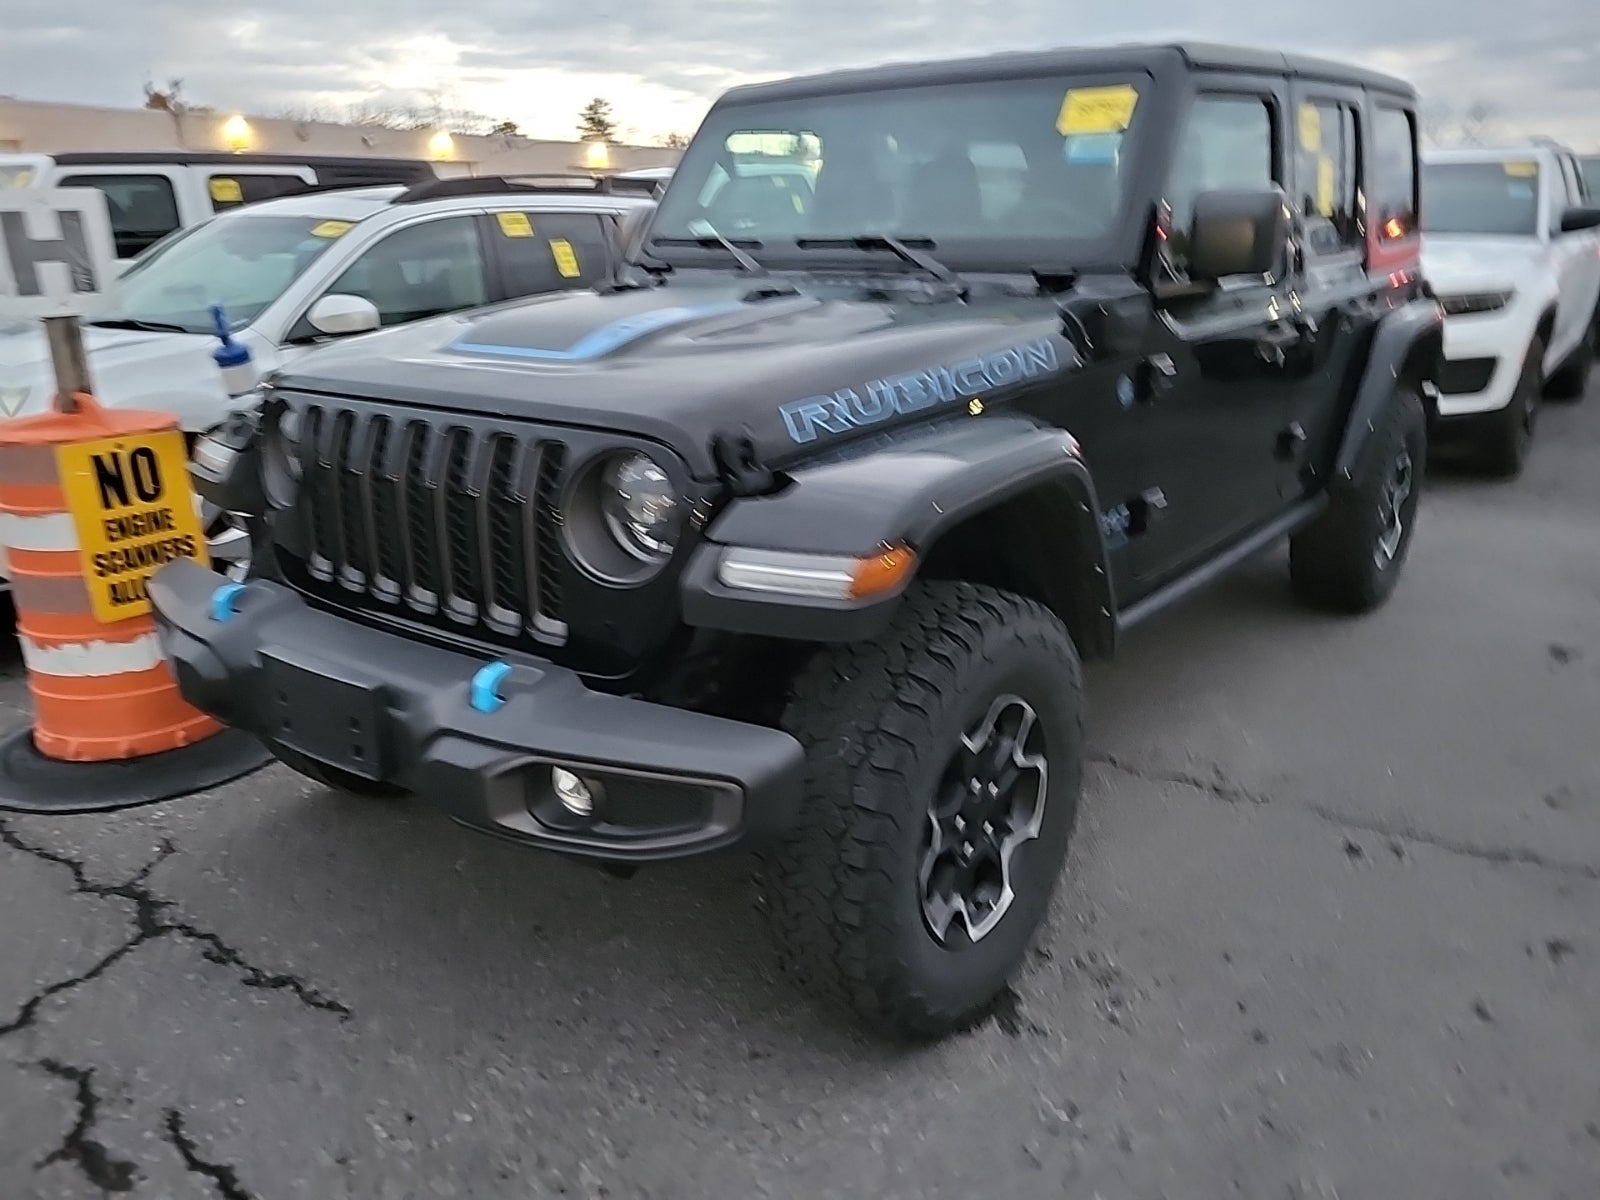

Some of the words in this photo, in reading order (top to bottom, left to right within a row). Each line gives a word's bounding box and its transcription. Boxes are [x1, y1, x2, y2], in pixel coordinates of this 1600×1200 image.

[1, 209, 97, 296] H
[778, 338, 1060, 444] RUBICON
[91, 446, 162, 509] NO
[93, 534, 196, 577] SCANNERS
[104, 507, 175, 542] ENGINE
